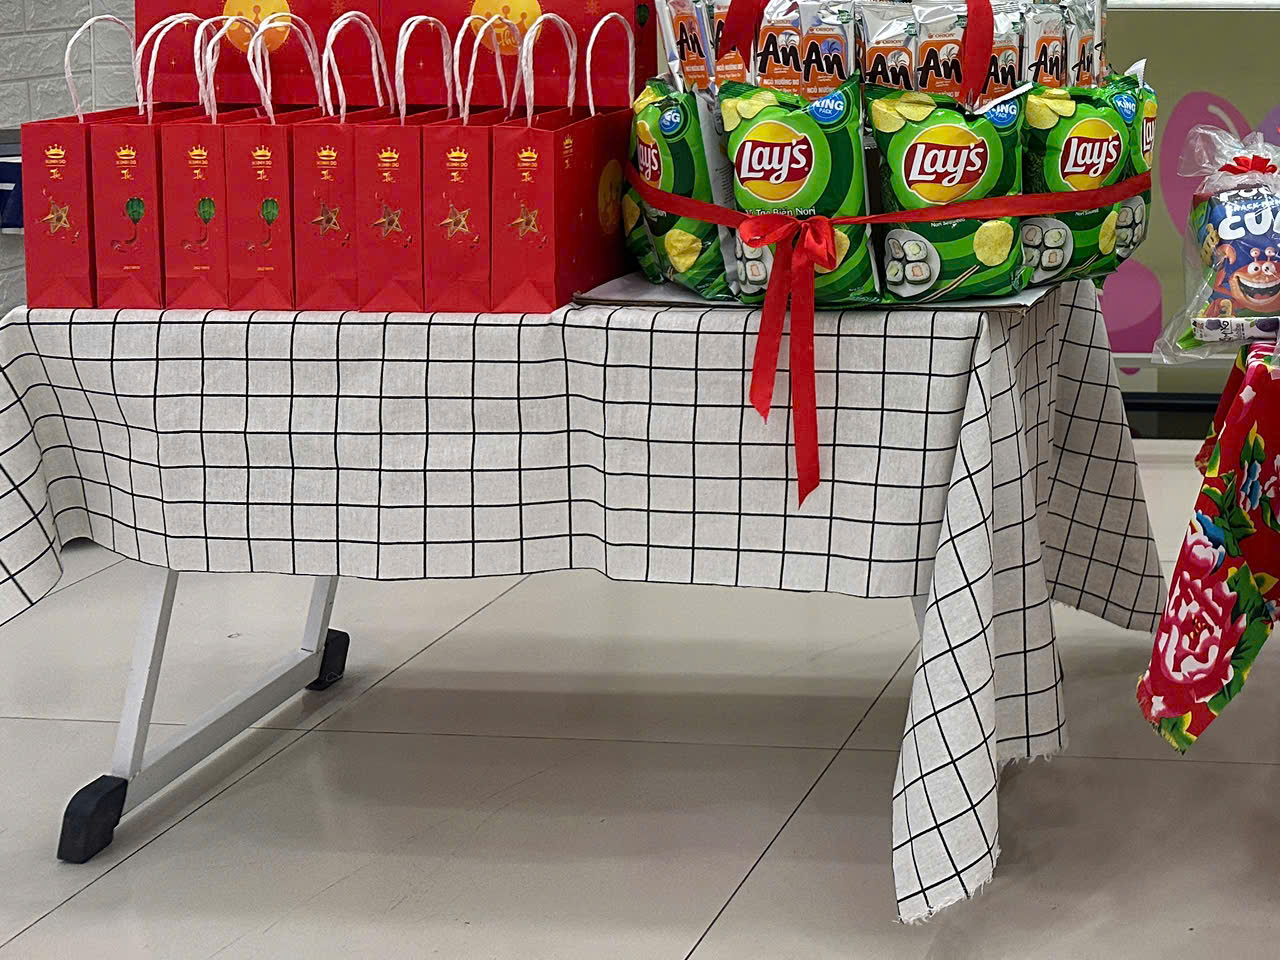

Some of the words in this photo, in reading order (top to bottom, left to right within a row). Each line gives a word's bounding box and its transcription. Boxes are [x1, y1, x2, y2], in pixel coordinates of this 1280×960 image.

[676, 21, 706, 60] An
[758, 33, 802, 73] An
[803, 40, 848, 82] An
[865, 54, 914, 90] An
[917, 47, 962, 88] An
[981, 55, 1017, 94] An
[1028, 43, 1060, 82] An
[638, 144, 659, 181] ay's
[741, 139, 808, 184] Lay's
[908, 143, 984, 187] Lay's
[1064, 137, 1120, 178] Lay's
[795, 206, 816, 216] Nori
